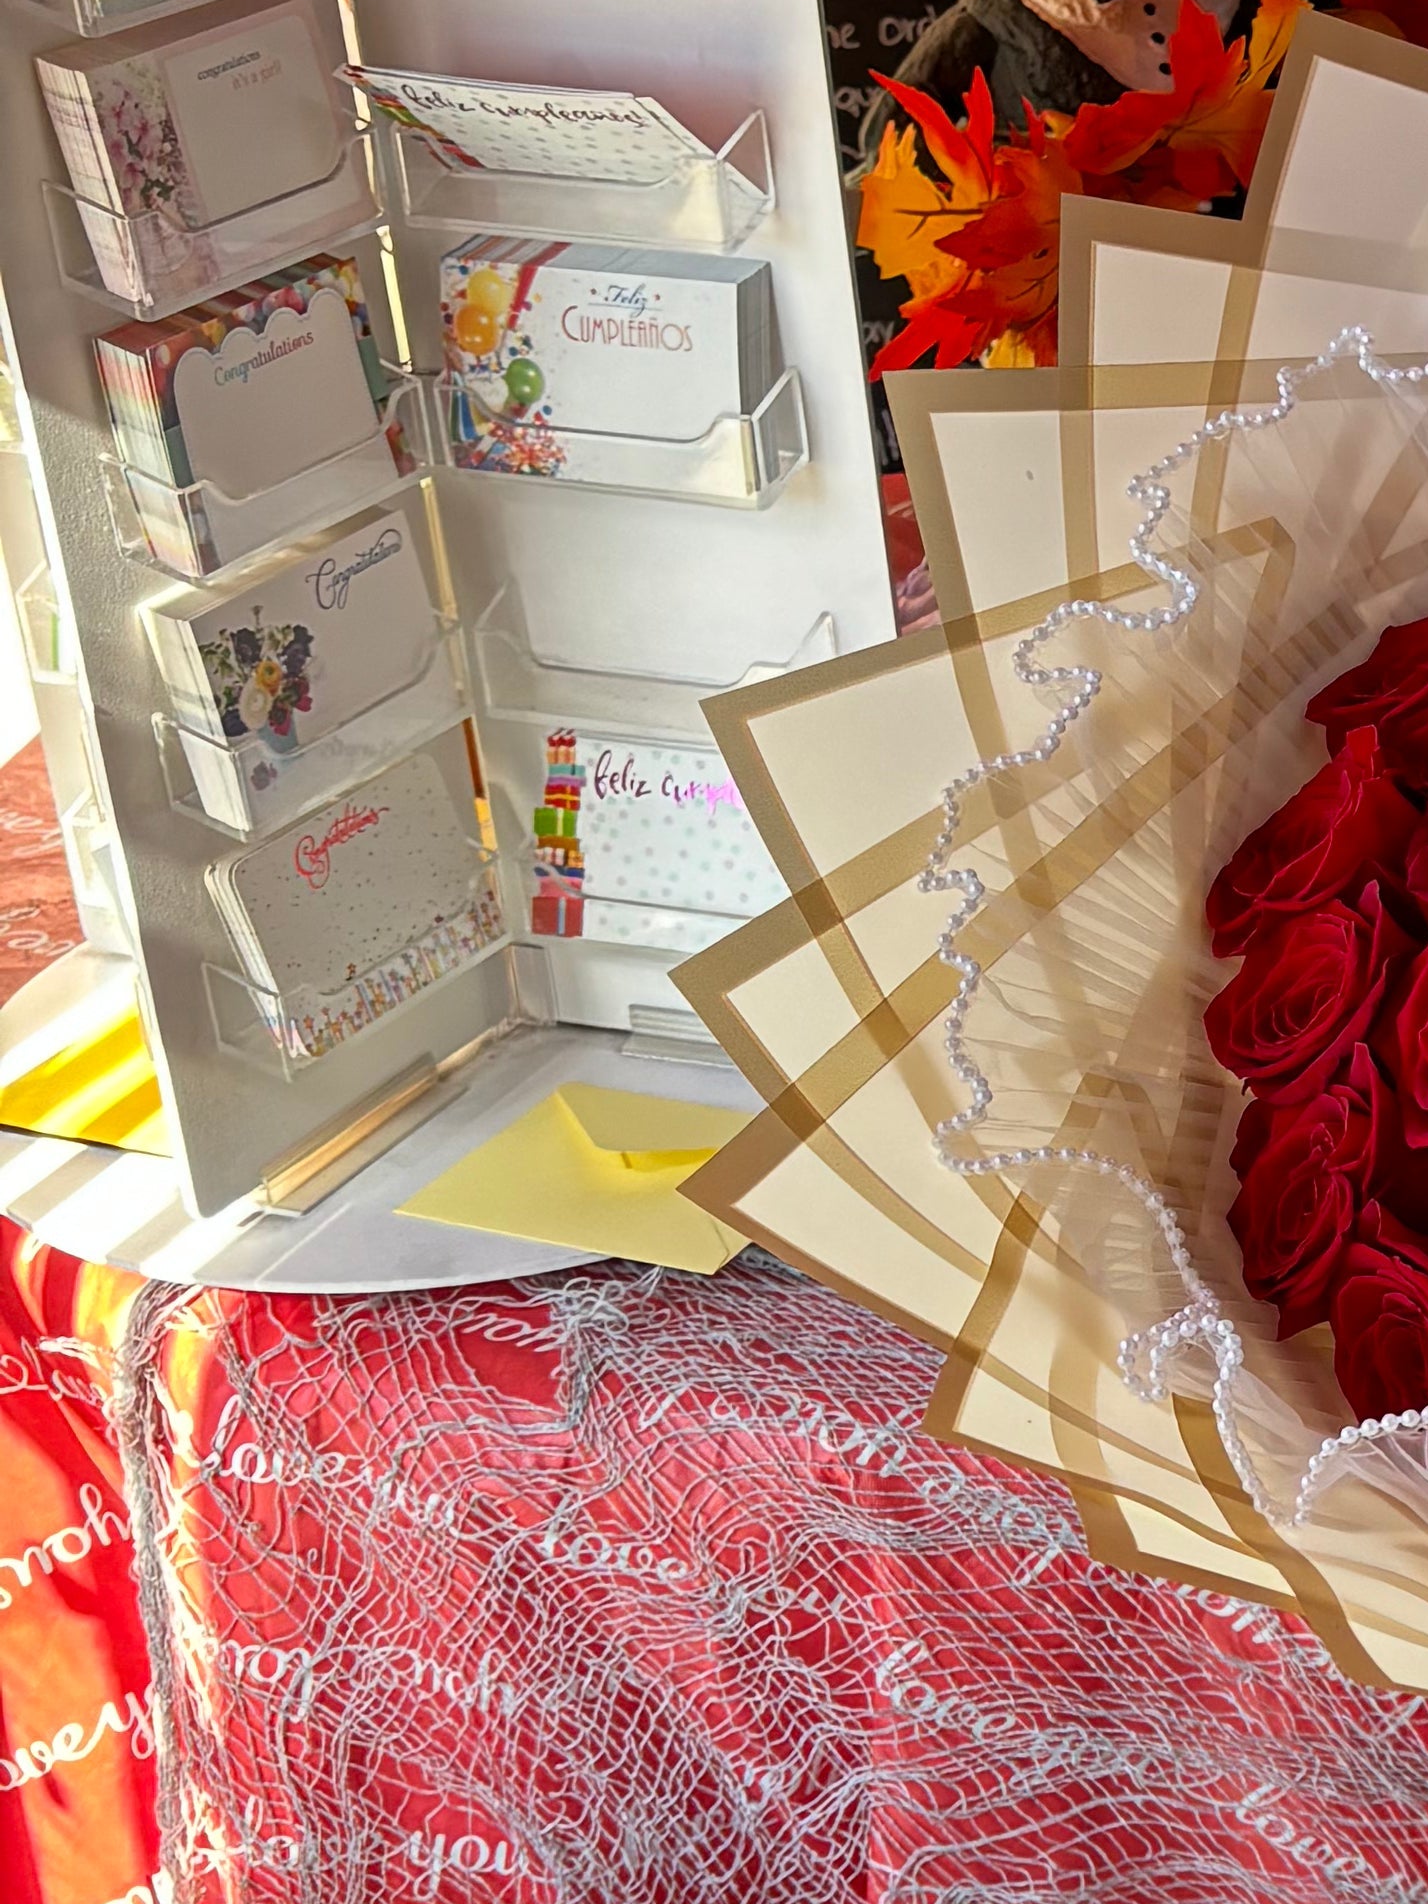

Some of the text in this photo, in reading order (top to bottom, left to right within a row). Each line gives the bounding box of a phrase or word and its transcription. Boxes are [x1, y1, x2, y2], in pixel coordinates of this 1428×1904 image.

[604, 282, 649, 319] Feliz
[214, 330, 314, 387] Congratulations
[594, 749, 652, 800] feliz
[408, 1827, 532, 1902] you
